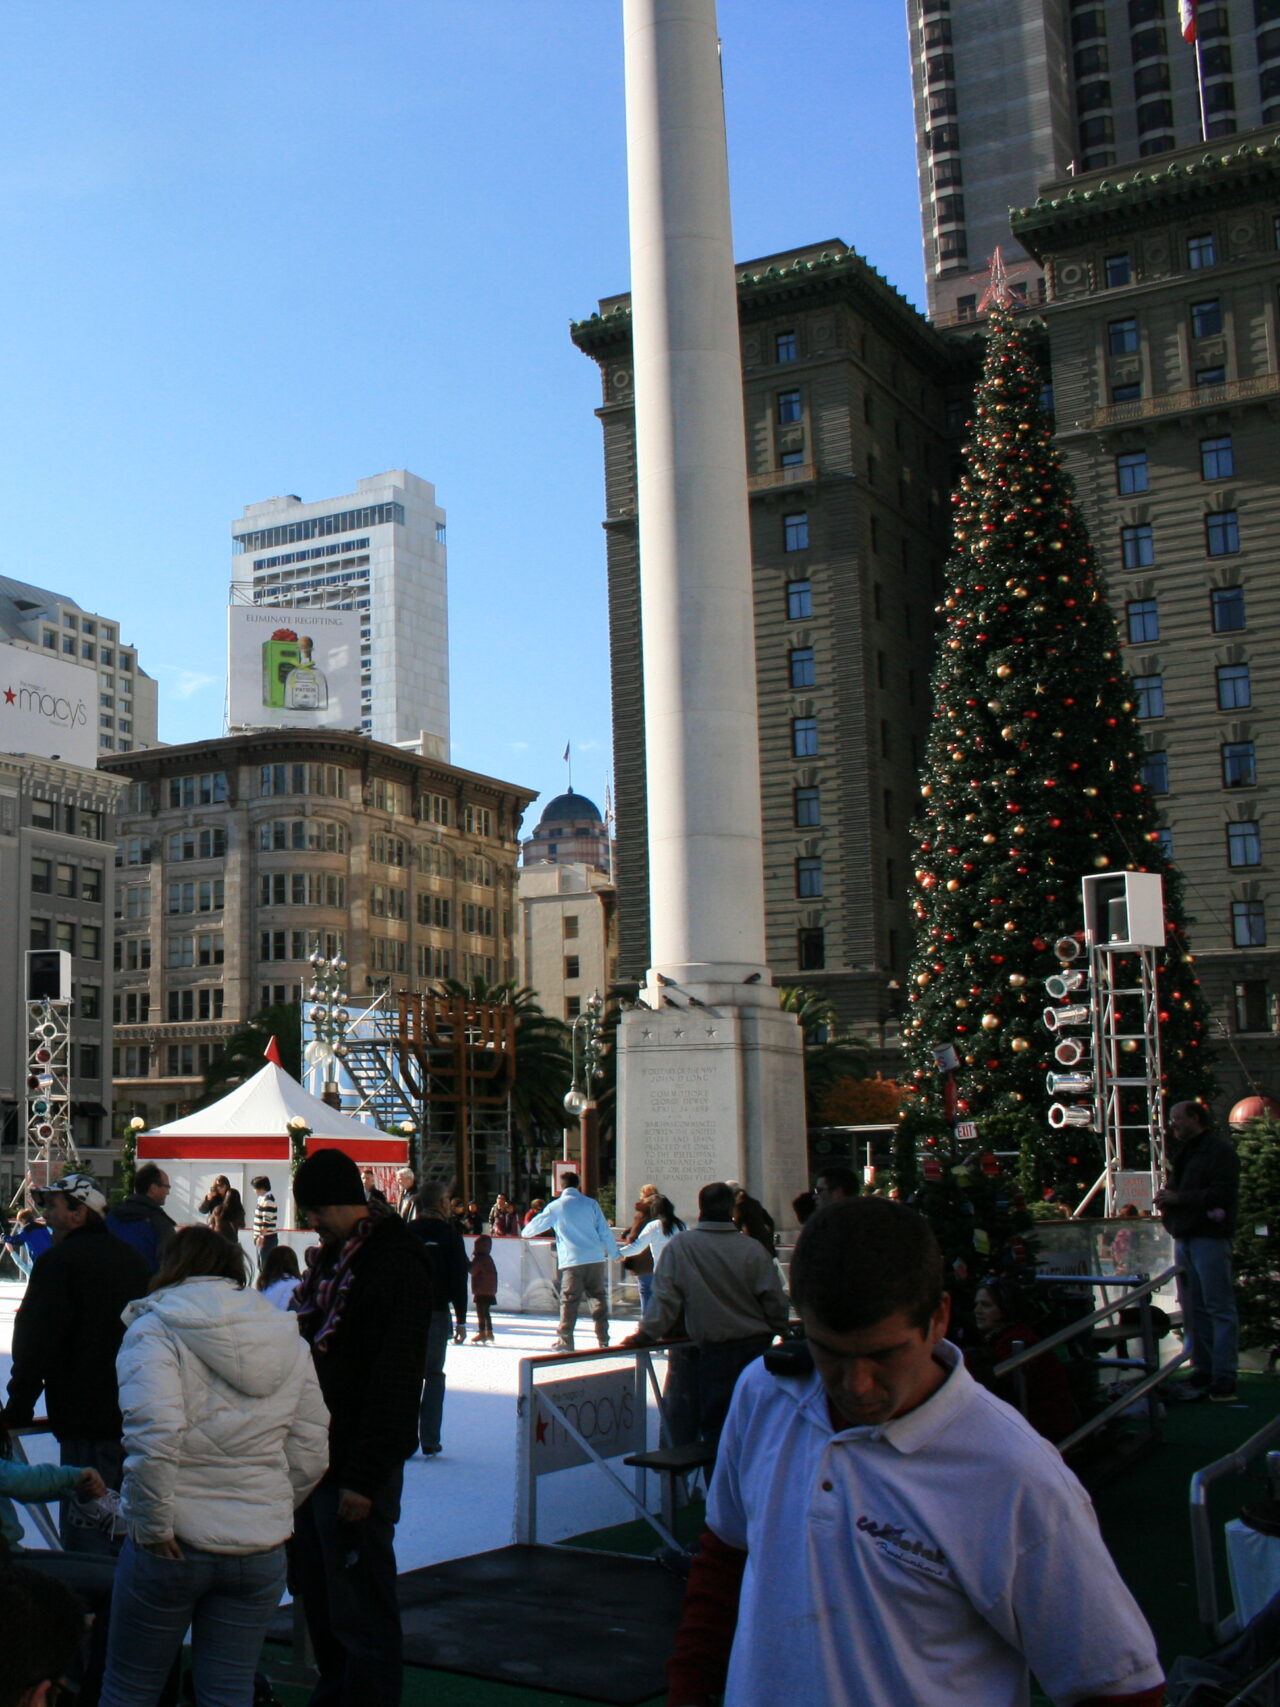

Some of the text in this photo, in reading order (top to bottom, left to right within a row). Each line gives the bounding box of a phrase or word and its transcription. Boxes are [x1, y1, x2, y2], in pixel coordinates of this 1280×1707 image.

[246, 614, 292, 624] ELIMINATE
[19, 688, 87, 729] macy's
[957, 1124, 973, 1138] EXIT
[551, 1385, 634, 1446] macy's
